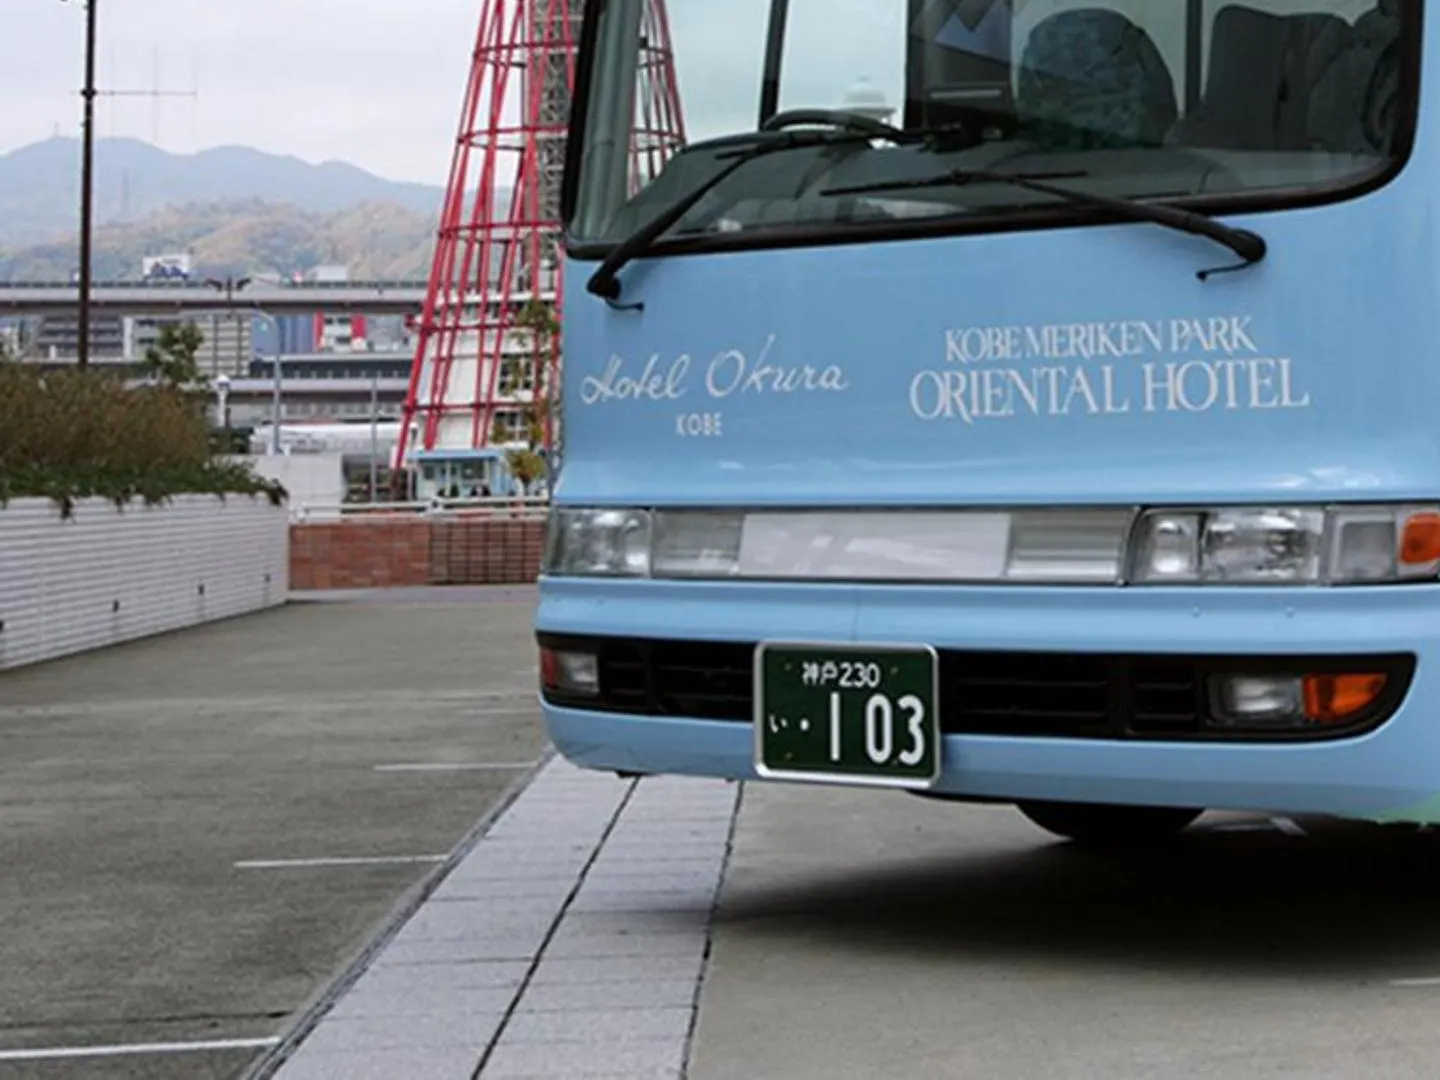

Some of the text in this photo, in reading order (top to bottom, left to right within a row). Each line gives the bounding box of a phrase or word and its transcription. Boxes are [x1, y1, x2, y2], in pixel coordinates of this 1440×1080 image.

[944, 315, 1258, 364] KOBE MERIKEN PARK
[579, 333, 850, 405] Hotel Okura
[908, 357, 1311, 424] ORIENTAL HOTEL
[675, 411, 724, 437] KOBE
